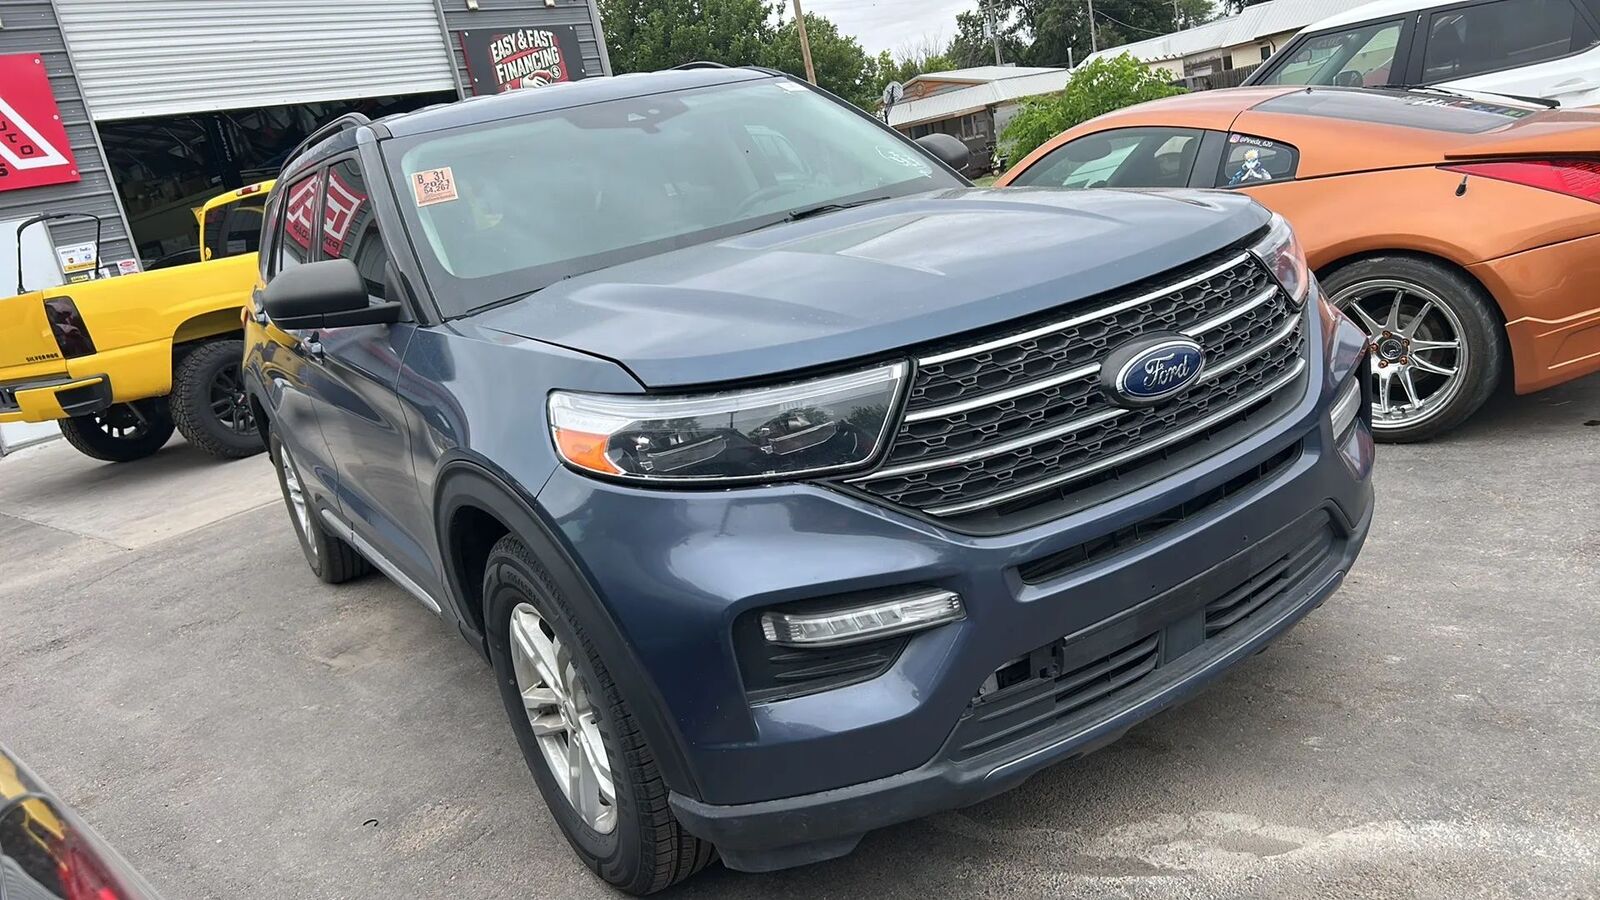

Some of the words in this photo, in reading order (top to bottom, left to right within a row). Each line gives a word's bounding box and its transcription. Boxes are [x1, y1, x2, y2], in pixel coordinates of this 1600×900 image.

[490, 35, 517, 62] EASY
[517, 29, 528, 49] &
[527, 29, 554, 48] FAST
[495, 46, 560, 85] FINANCING
[433, 170, 445, 181] 31
[1143, 352, 1190, 390] Ford
